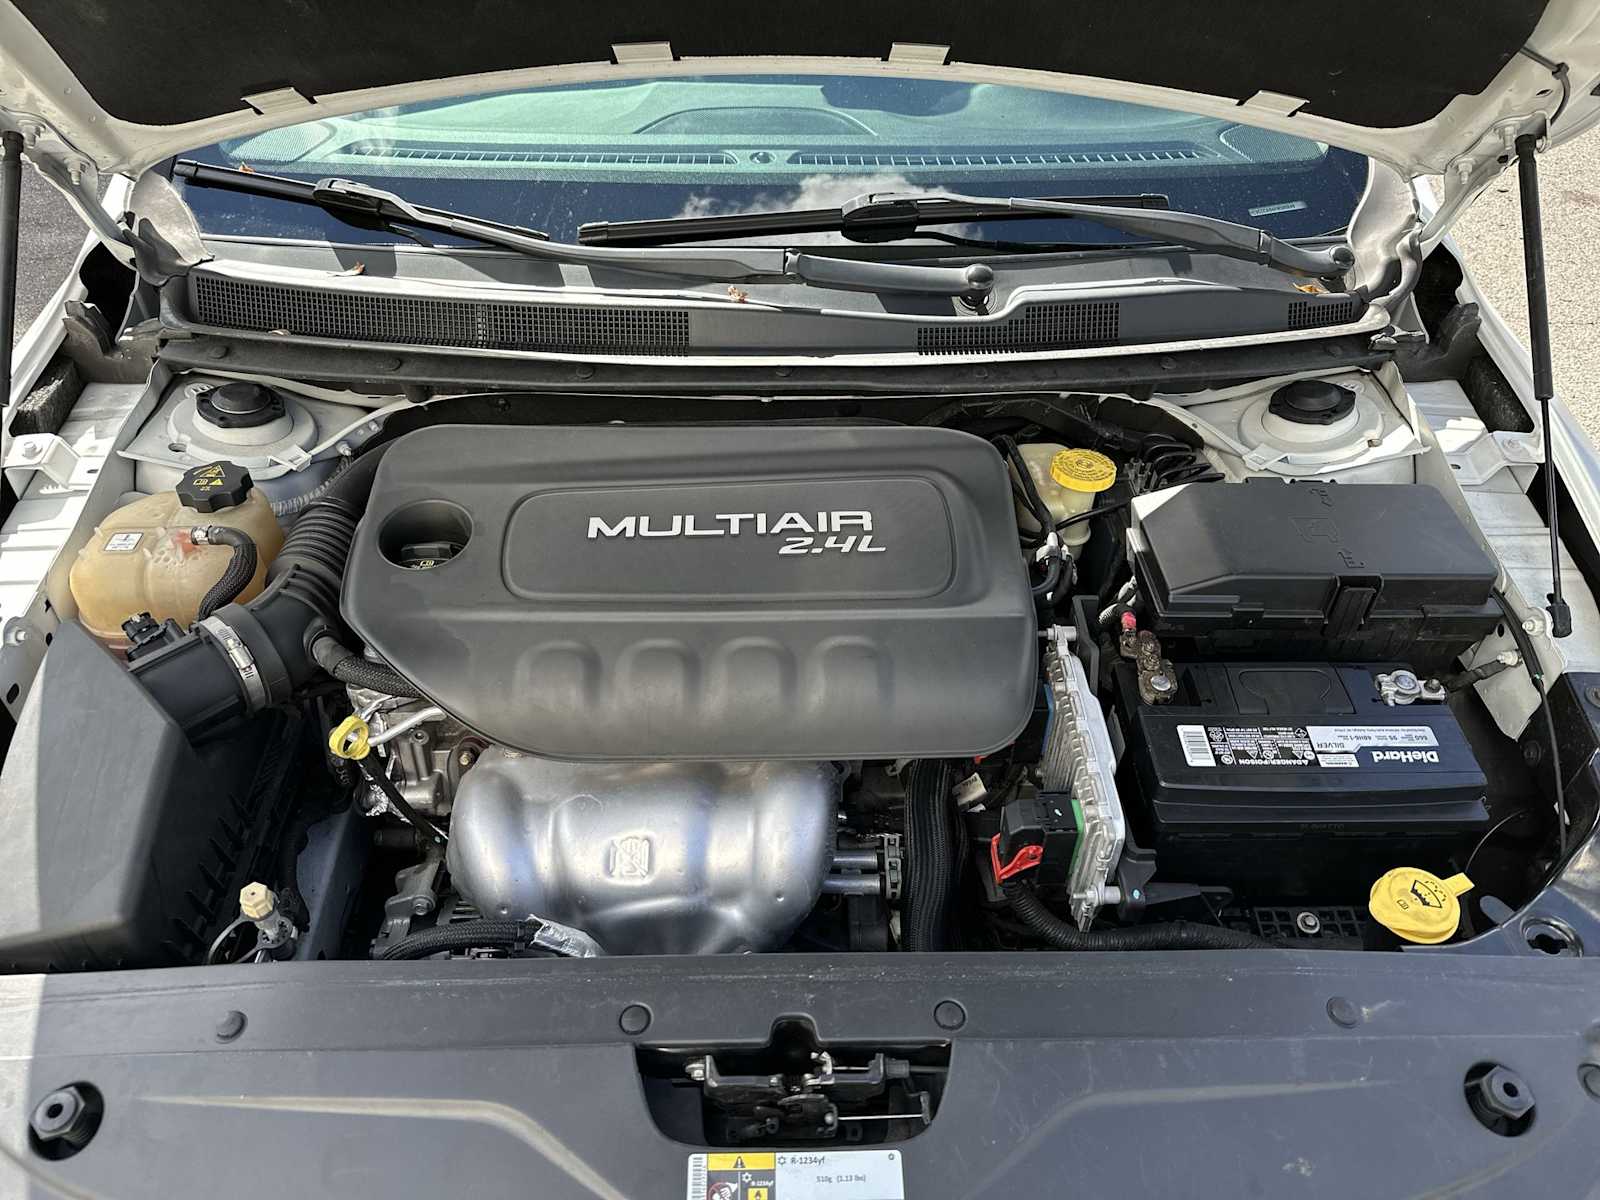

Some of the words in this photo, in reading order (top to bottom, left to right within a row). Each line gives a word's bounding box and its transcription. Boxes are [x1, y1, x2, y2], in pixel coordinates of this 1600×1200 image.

[587, 510, 873, 539] MULTIAIR
[778, 535, 887, 555] 2.4L
[1371, 750, 1440, 764] DieHard
[790, 1156, 825, 1166] R-1234yf
